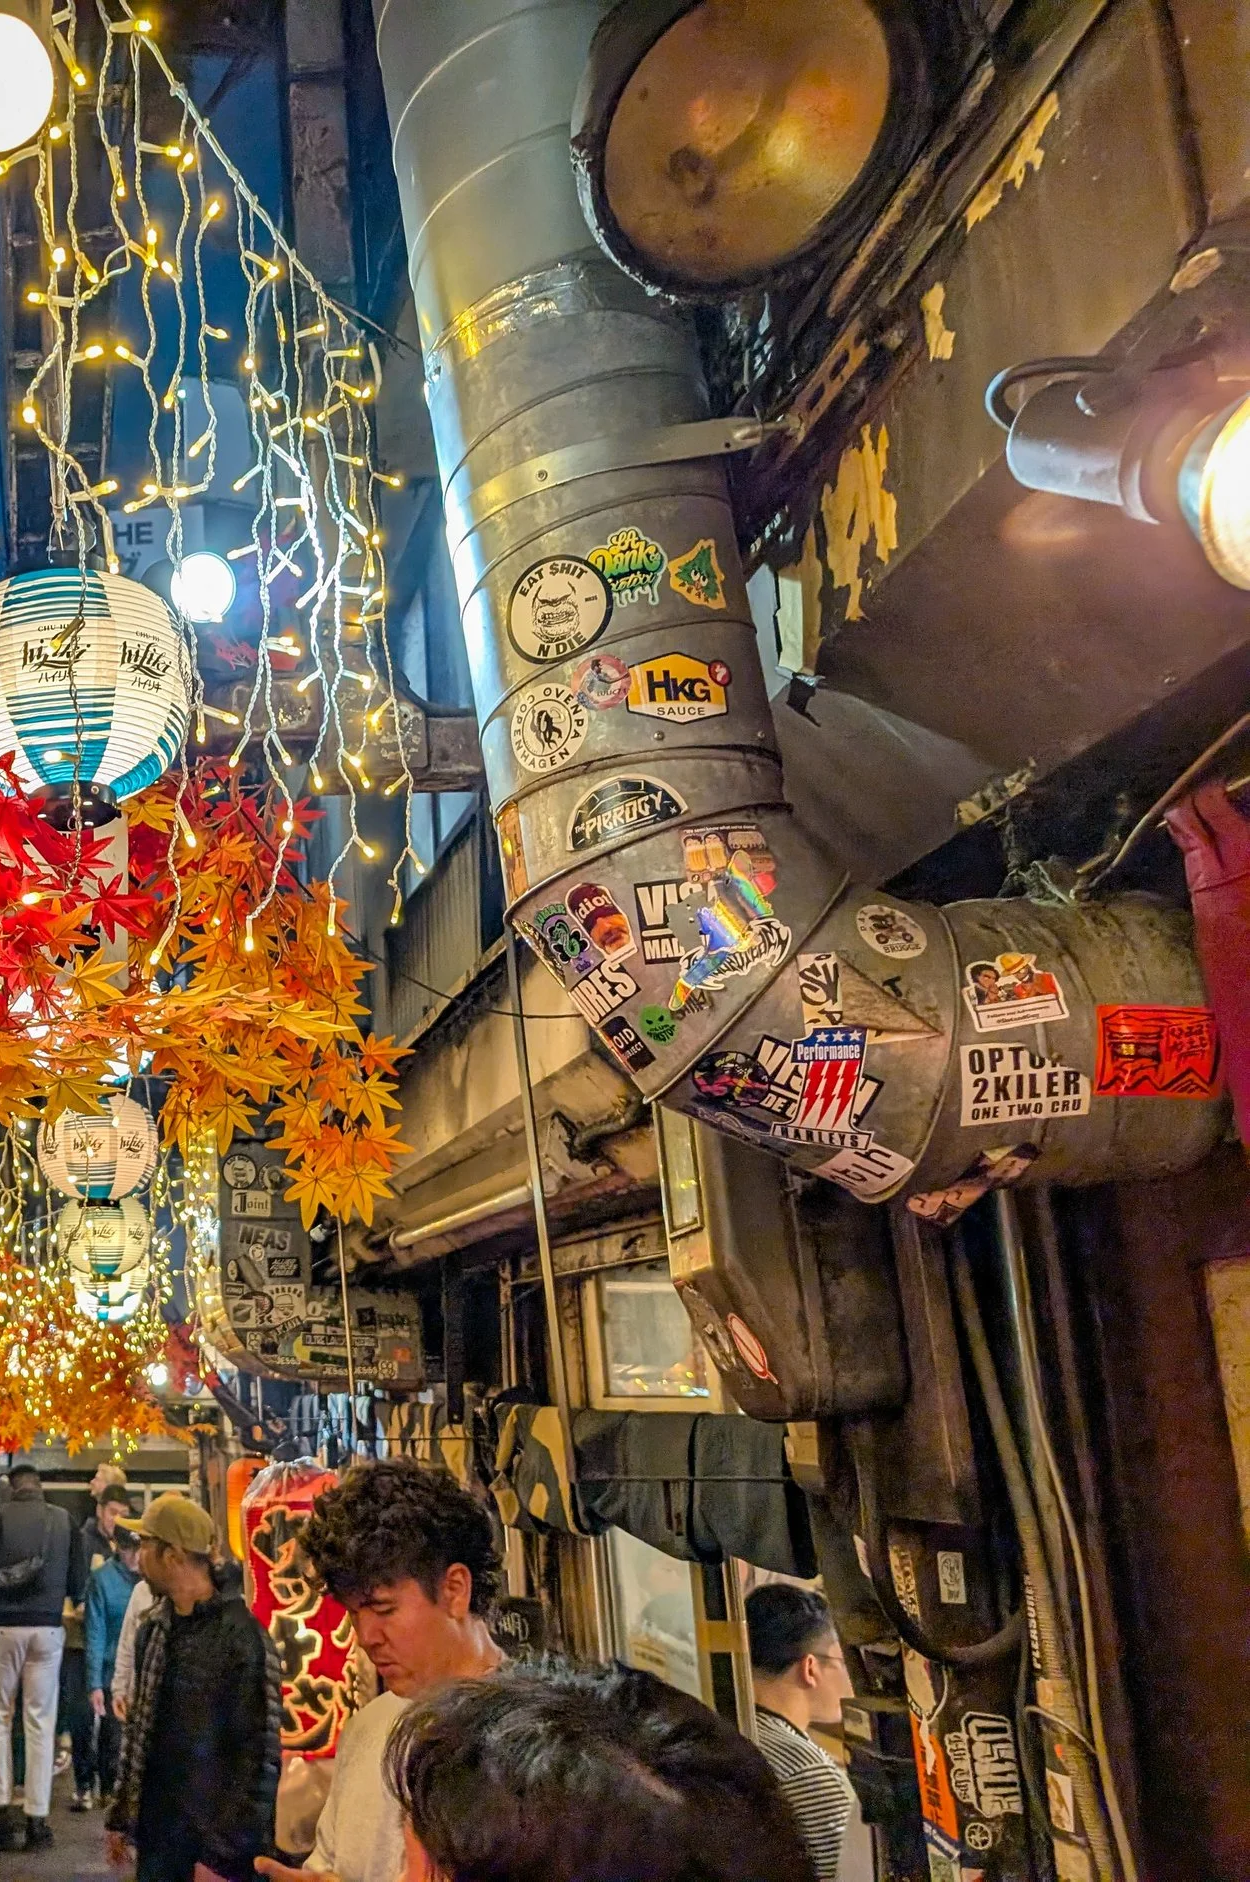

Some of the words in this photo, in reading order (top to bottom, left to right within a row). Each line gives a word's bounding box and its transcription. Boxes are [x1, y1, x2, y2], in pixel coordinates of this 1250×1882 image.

[518, 567, 545, 598] EAT
[549, 562, 588, 580] $HIT
[536, 643, 551, 657] N
[554, 631, 588, 656] DIE
[646, 670, 712, 703] HKG
[656, 706, 706, 716] SAUCE
[513, 694, 570, 769] COPENHAGEN
[796, 1043, 861, 1061] Performance
[970, 1105, 1000, 1121] ONE
[1007, 1102, 1044, 1116] TWO
[1050, 1098, 1082, 1114] CRU
[778, 1125, 860, 1148] HARLEYS
